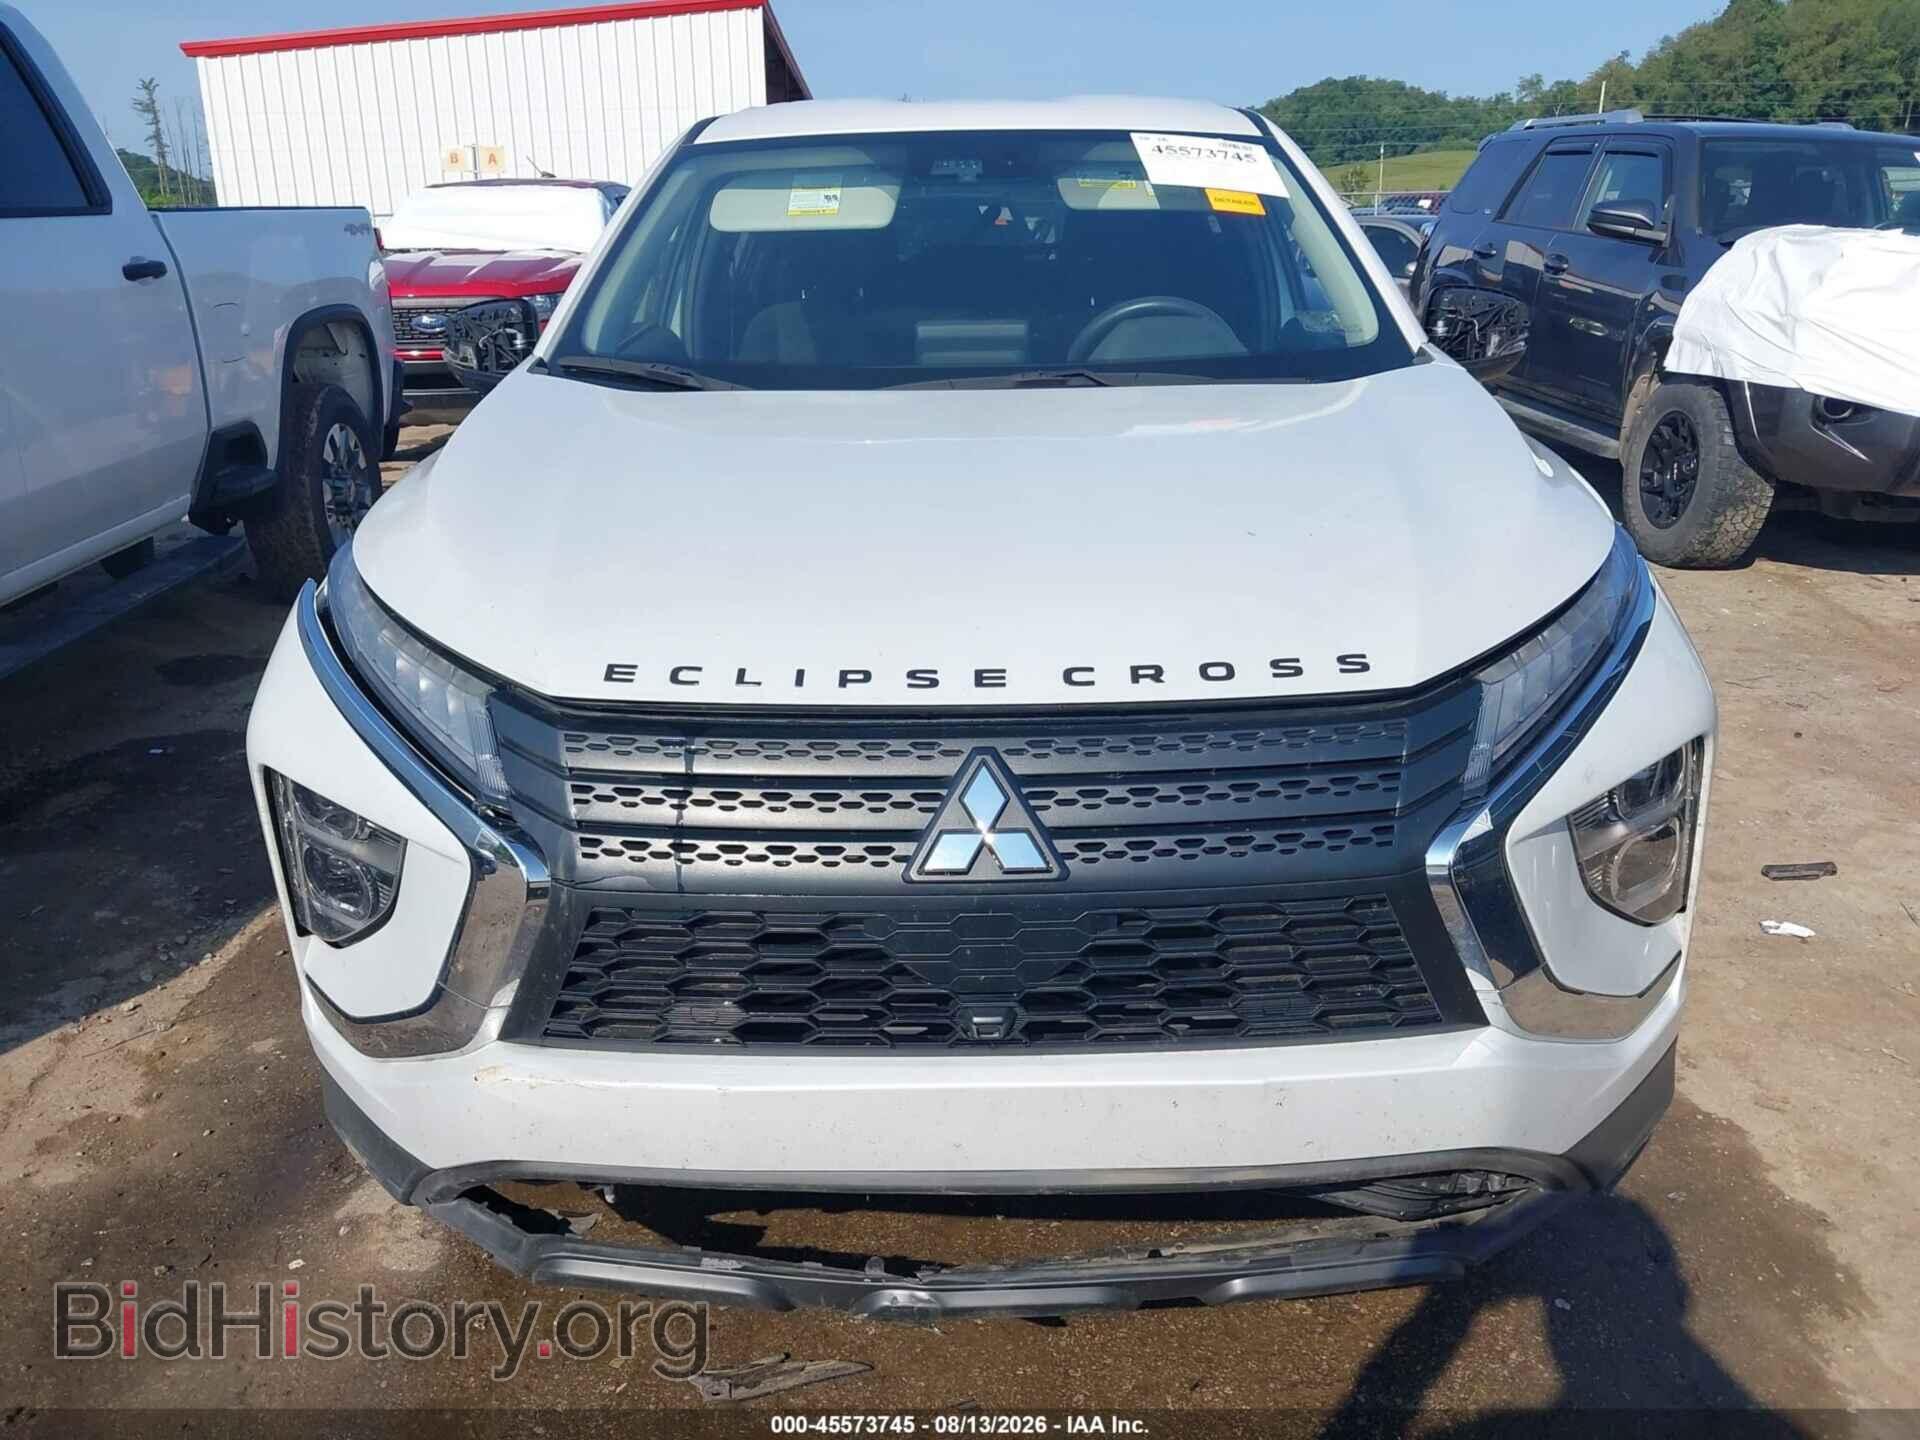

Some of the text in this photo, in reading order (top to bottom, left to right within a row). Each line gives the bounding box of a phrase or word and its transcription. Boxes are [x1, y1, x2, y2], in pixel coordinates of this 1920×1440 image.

[449, 152, 459, 165] B
[488, 152, 498, 167] A
[1151, 144, 1257, 163] 45573745
[603, 653, 1371, 689] ECLIPSE CROSS
